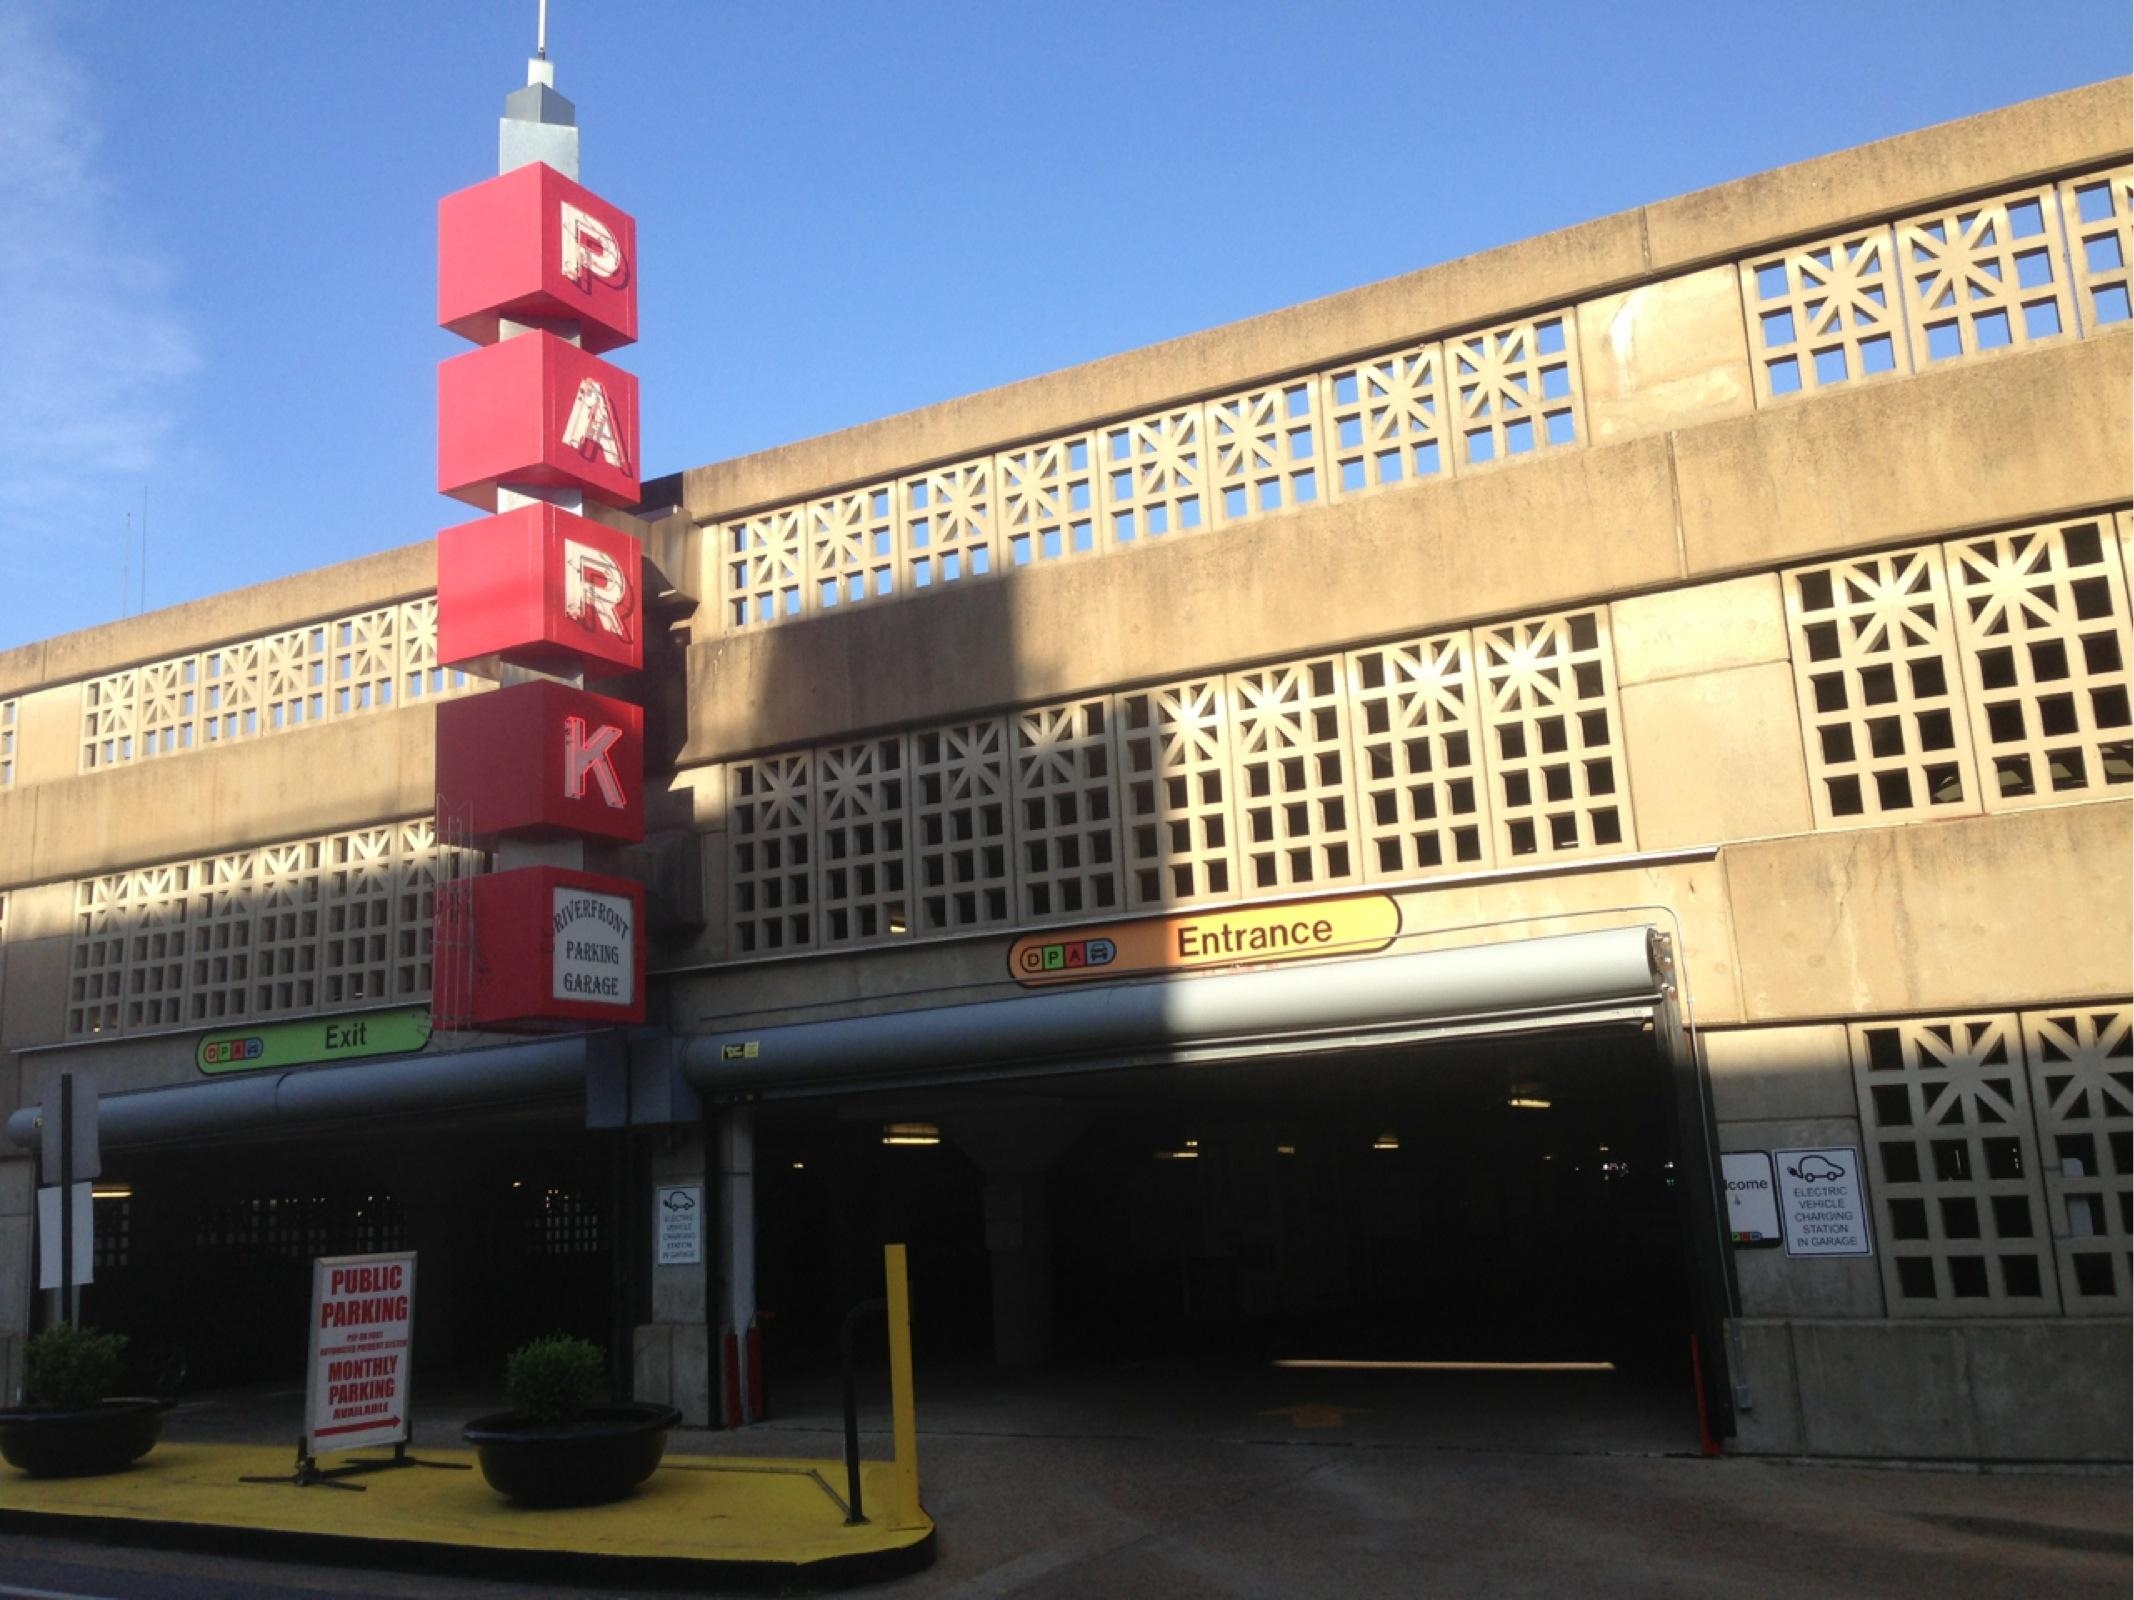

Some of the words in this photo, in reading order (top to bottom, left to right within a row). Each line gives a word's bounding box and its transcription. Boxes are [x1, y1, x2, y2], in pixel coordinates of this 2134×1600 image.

[554, 898, 629, 940] RIVERFRONT
[1177, 918, 1333, 958] Entrance
[566, 940, 619, 965] PARKING
[563, 972, 619, 996] GARAGE
[325, 1022, 367, 1049] Exit
[1794, 1186, 1848, 1197] ELECTRIC
[1799, 1199, 1845, 1209] VEHICLE
[1794, 1211, 1853, 1222] CHARGING
[1802, 1224, 1848, 1234] STATION
[1797, 1237, 1808, 1247] IN
[1811, 1236, 1857, 1246] GARAGE
[331, 1264, 403, 1296] PUBLIC
[321, 1296, 408, 1329] PARKING
[328, 1355, 398, 1382] MONTHLY
[328, 1378, 394, 1405] PARKING
[333, 1401, 389, 1420] AVAILABLE
